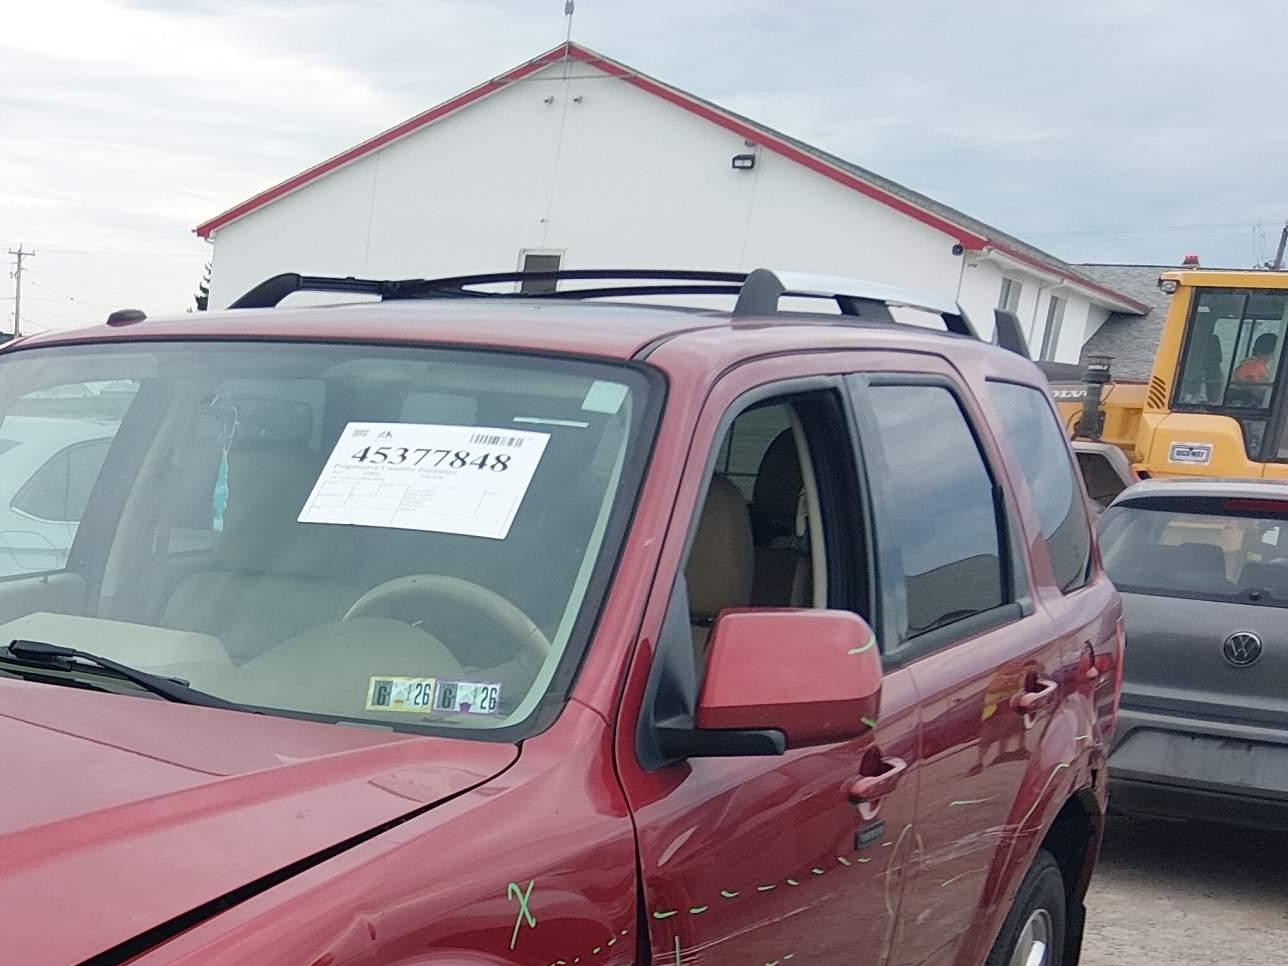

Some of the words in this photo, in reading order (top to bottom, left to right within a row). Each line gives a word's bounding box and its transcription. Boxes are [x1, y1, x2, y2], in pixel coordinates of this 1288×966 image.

[351, 446, 512, 473] 45377848
[376, 685, 388, 706] 6
[414, 683, 432, 707] 26
[480, 687, 498, 710] 26
